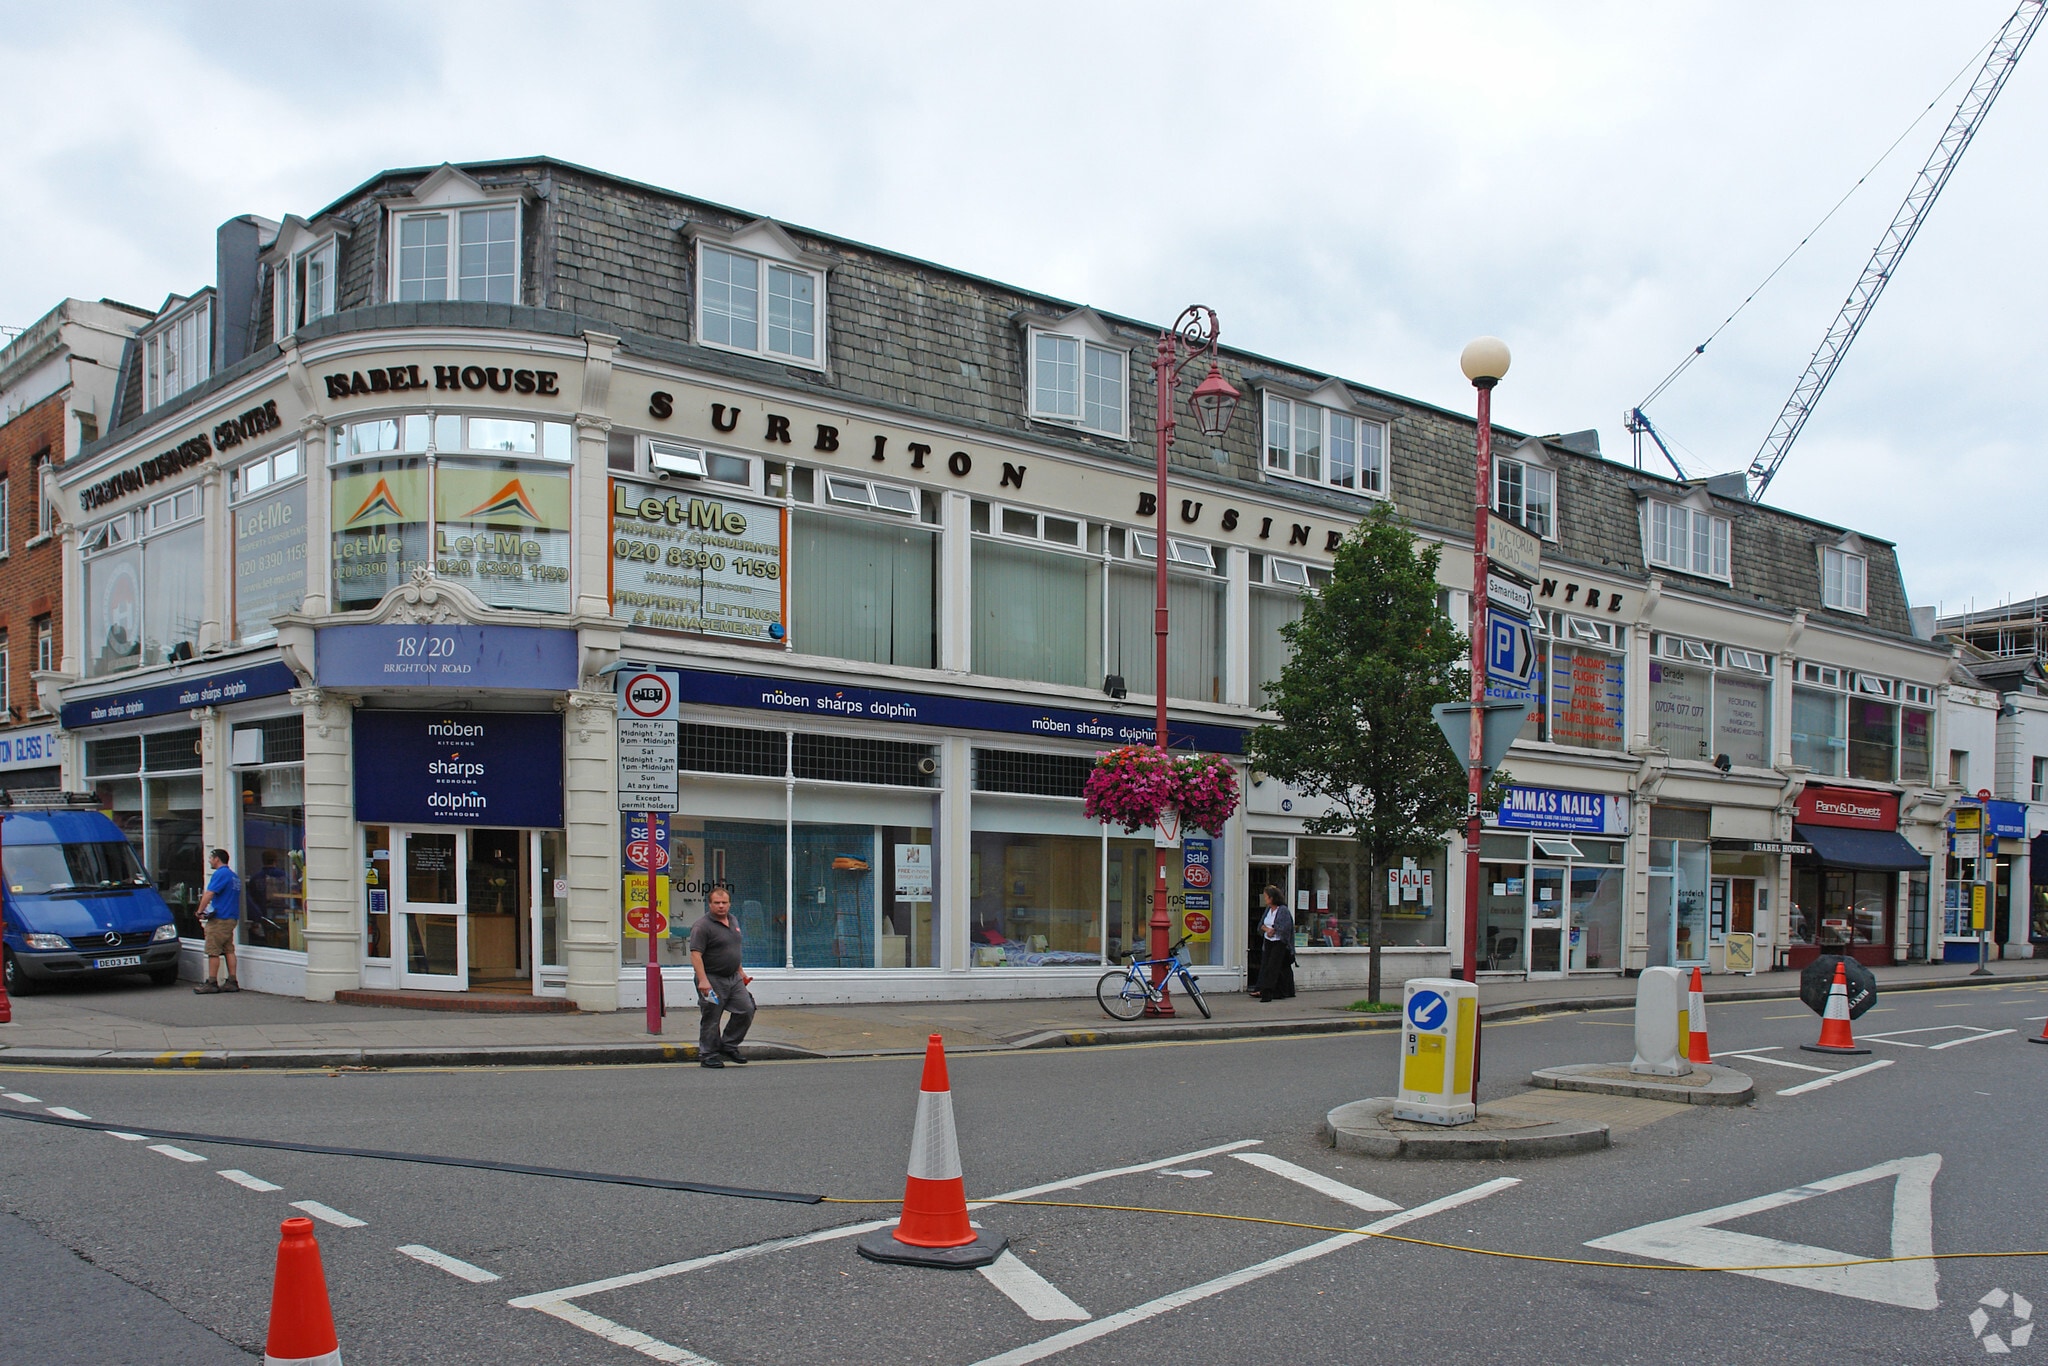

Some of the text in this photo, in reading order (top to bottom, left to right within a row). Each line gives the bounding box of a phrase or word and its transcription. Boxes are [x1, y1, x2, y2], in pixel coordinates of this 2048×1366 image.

[324, 364, 560, 399] ISABEL HOUSE
[213, 399, 281, 451] CENTRE
[615, 485, 747, 534] Let-Me
[648, 390, 1624, 613] SURBITON BUSINE NTRE
[239, 501, 293, 540] Let-Me
[436, 530, 541, 558] Let-Me
[615, 519, 780, 557] PROPERTY CONSULTANTS
[1499, 525, 1534, 556] VICTORIA
[332, 534, 403, 561] Let-Me
[1498, 542, 1520, 564] ROAD
[240, 543, 307, 577] 020 8390 1159
[615, 538, 781, 580] 020 8390 1159
[332, 565, 353, 579] 020
[356, 561, 388, 576] 8390
[436, 559, 569, 581] 020 8390 1159
[1489, 579, 1526, 604] Samaritans
[615, 589, 780, 623] PROPERTY LETTINGS
[634, 610, 764, 636] & MANAGEMENT
[396, 636, 455, 657] 18/20
[383, 663, 472, 674] BRIGHTON ROAD
[1572, 655, 1606, 671] HOLIDAYS
[1572, 669, 1604, 684] FLIGHTS
[1662, 667, 1684, 681] Grade
[201, 688, 222, 701] sharps
[223, 682, 247, 698] dolphin
[1574, 684, 1602, 698] HOTELS
[126, 702, 144, 716] dolphin
[762, 690, 917, 718] möben sharps dolphin
[1571, 699, 1606, 713] CAR HIRE
[1655, 700, 1705, 718] 07074 077 077
[428, 719, 485, 738] möben
[1561, 712, 1582, 724] TRAVEL
[1583, 714, 1615, 728] INSURANCE
[621, 730, 653, 739] Midnight
[1032, 717, 1158, 742] möben sharps dolphin
[16, 735, 42, 761] GLASS
[643, 738, 676, 746] Midnight
[428, 758, 485, 779] sharps
[621, 756, 653, 765] Midnight
[641, 764, 674, 772] Midnight
[638, 783, 652, 791] any
[653, 782, 669, 790] time
[427, 791, 487, 811] dolphin
[647, 802, 675, 810] holders
[1283, 801, 1292, 809] 48
[1503, 789, 1557, 813] EMMA'S
[1561, 794, 1601, 817] NAILS
[1815, 800, 1881, 816] Parry & Drewett
[631, 827, 666, 840] sae
[1753, 842, 1806, 854] ISABEL HOUSE
[1187, 851, 1209, 864] sale
[1390, 872, 1431, 886] SALE
[1146, 894, 1186, 905] srps
[1678, 889, 1704, 897] Sandwich
[99, 957, 140, 968] DE03 ZTL
[1409, 1034, 1416, 1042] B
[1410, 1046, 1415, 1054] 1
